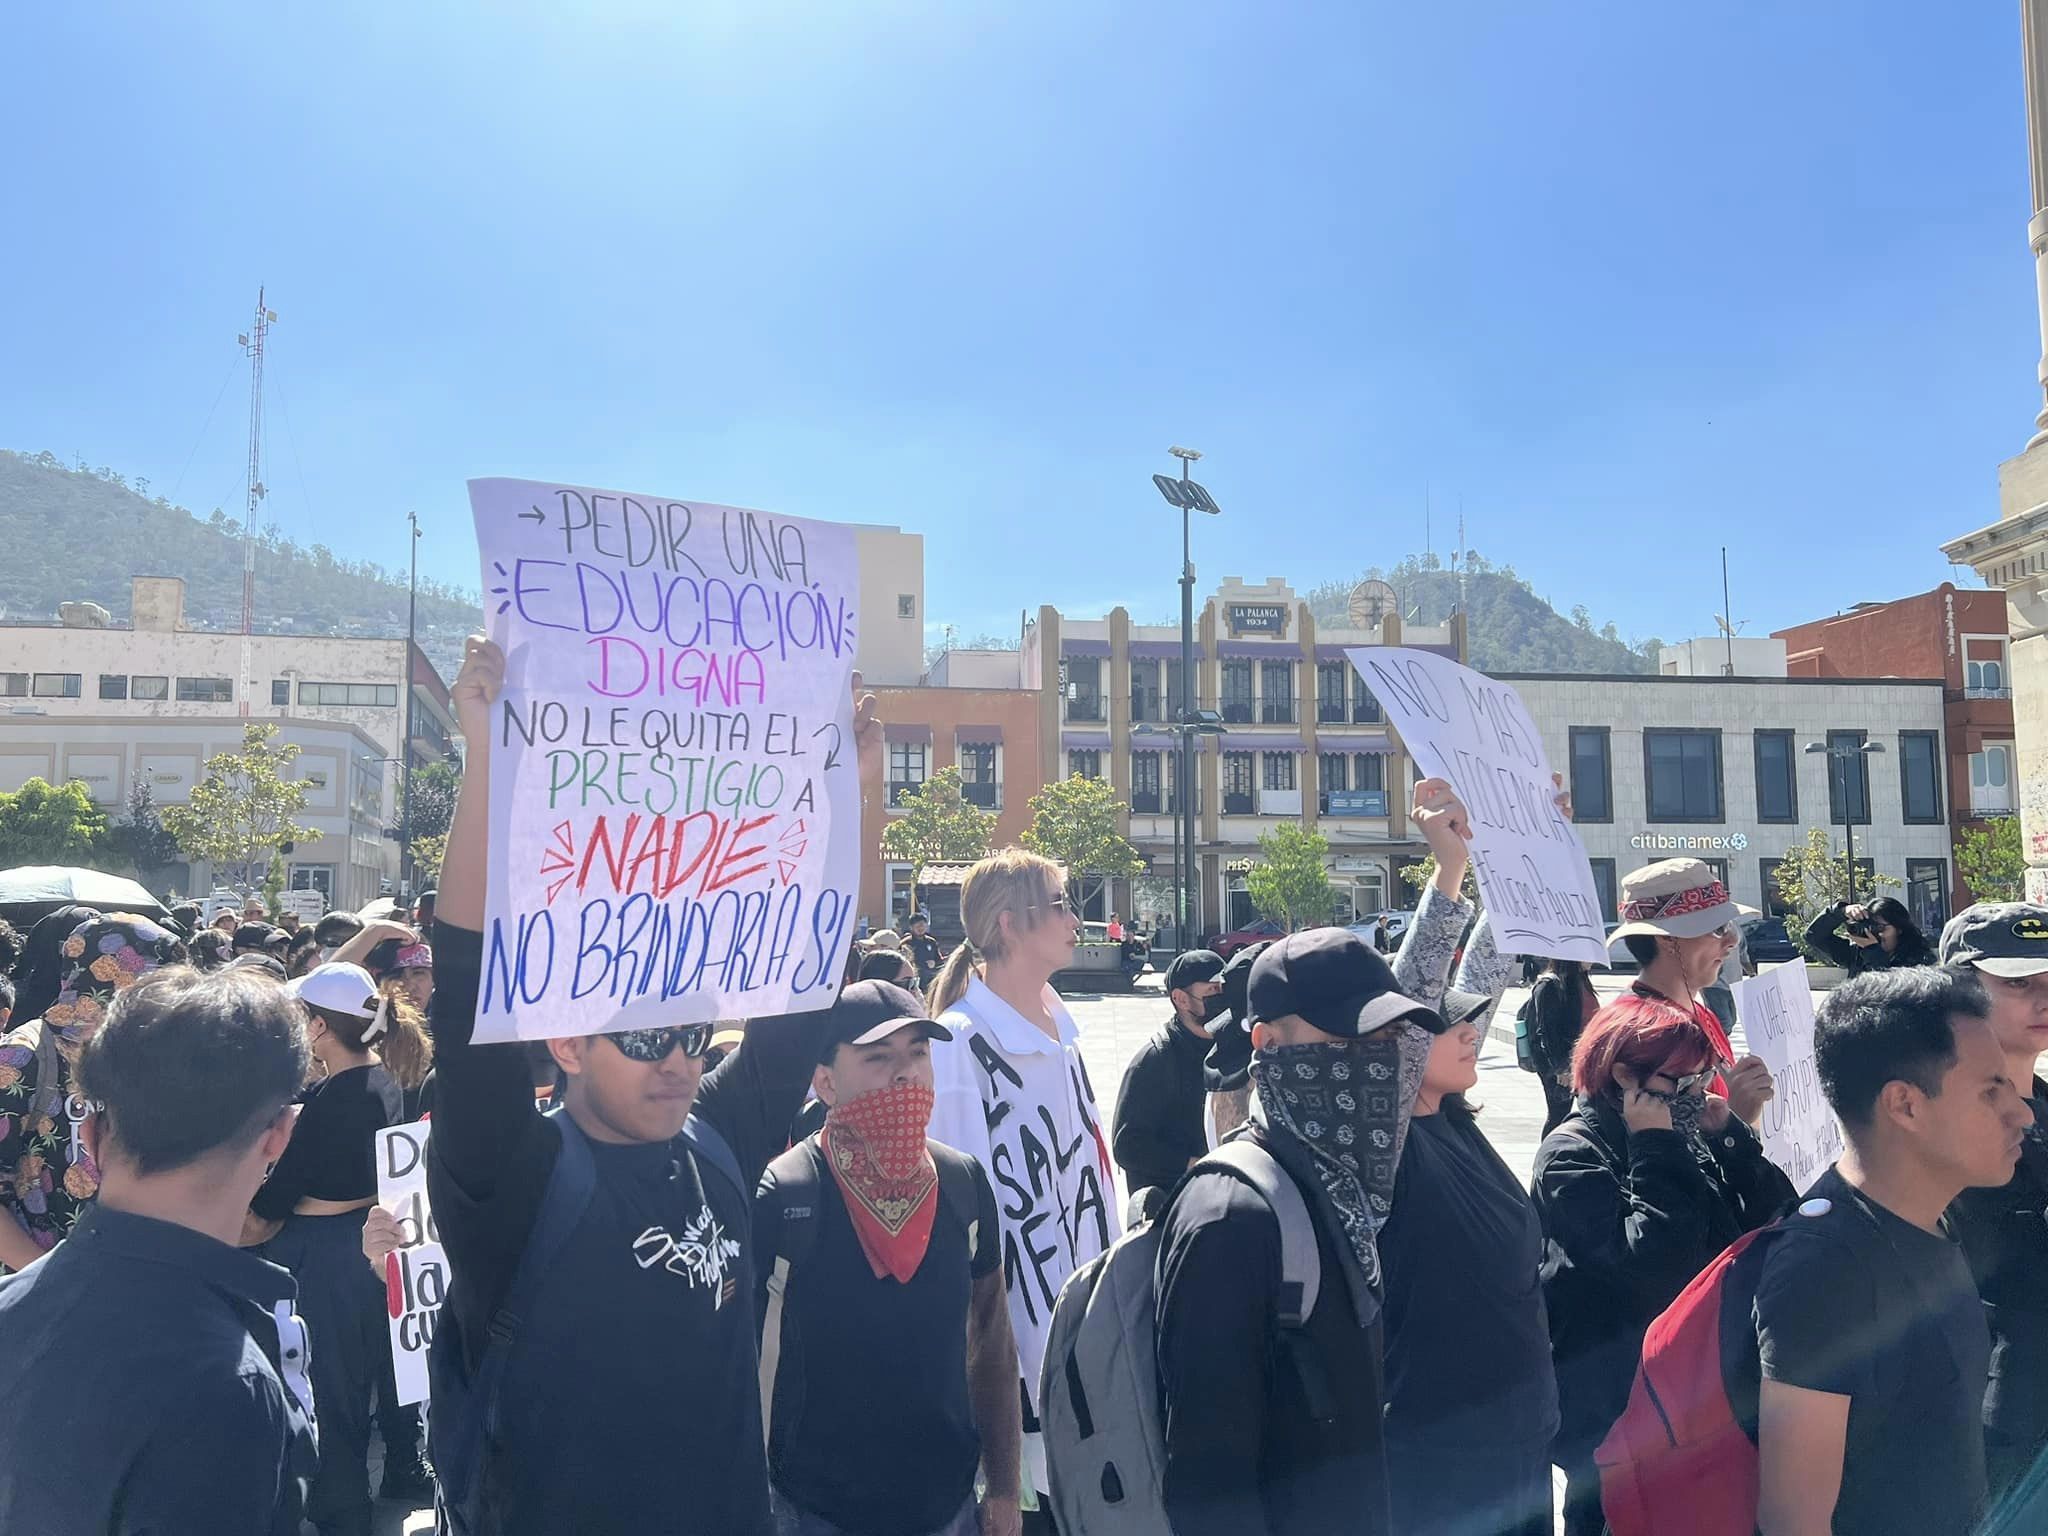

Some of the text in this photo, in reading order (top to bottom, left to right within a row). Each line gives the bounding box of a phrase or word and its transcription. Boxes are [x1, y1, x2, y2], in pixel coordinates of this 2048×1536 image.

[555, 490, 808, 585] PEDIR UNA
[514, 558, 844, 661] EDUCACIÓN
[1235, 607, 1279, 618] LA PALANCA
[587, 636, 765, 708] DIGNA
[503, 700, 806, 758] NO LE QUITA EL
[1368, 658, 1538, 768] NO MAS
[545, 750, 815, 820] PRESTIGIO A
[1630, 832, 1731, 849] citibanamex
[482, 908, 555, 1015] NO
[1762, 1055, 1822, 1140] CORRUPT
